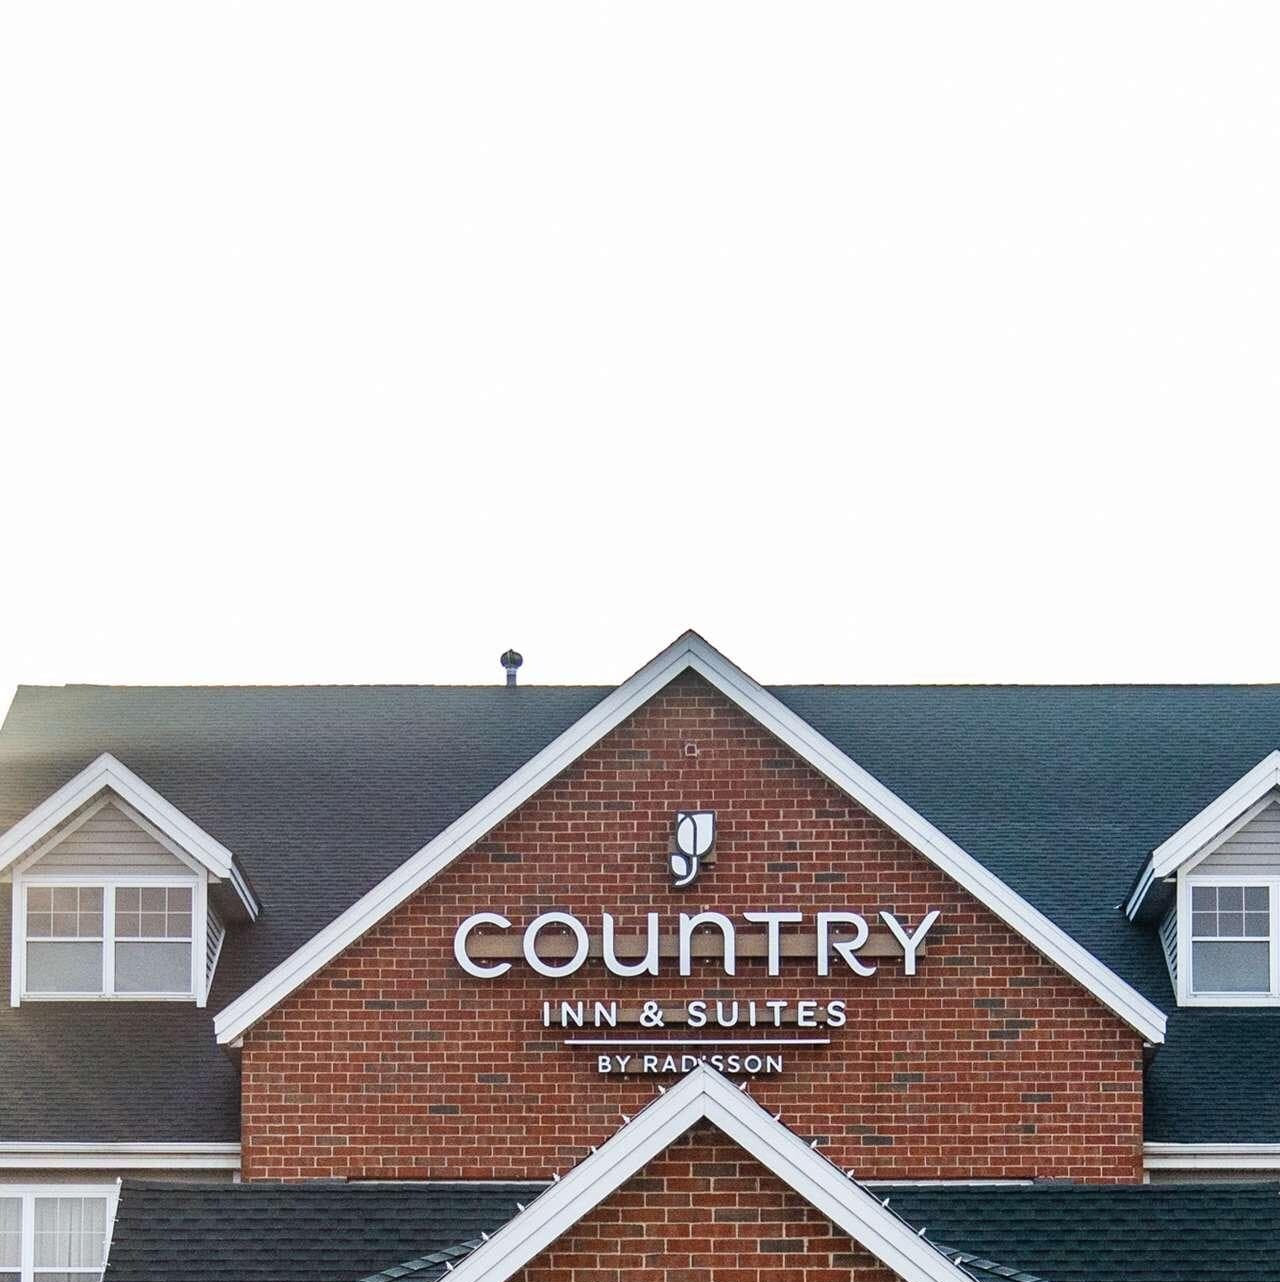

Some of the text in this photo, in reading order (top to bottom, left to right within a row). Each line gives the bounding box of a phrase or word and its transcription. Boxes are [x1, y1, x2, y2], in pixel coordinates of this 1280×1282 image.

[543, 1001, 847, 1028] INN & SUITES
[598, 1055, 782, 1073] BY RADSSON
